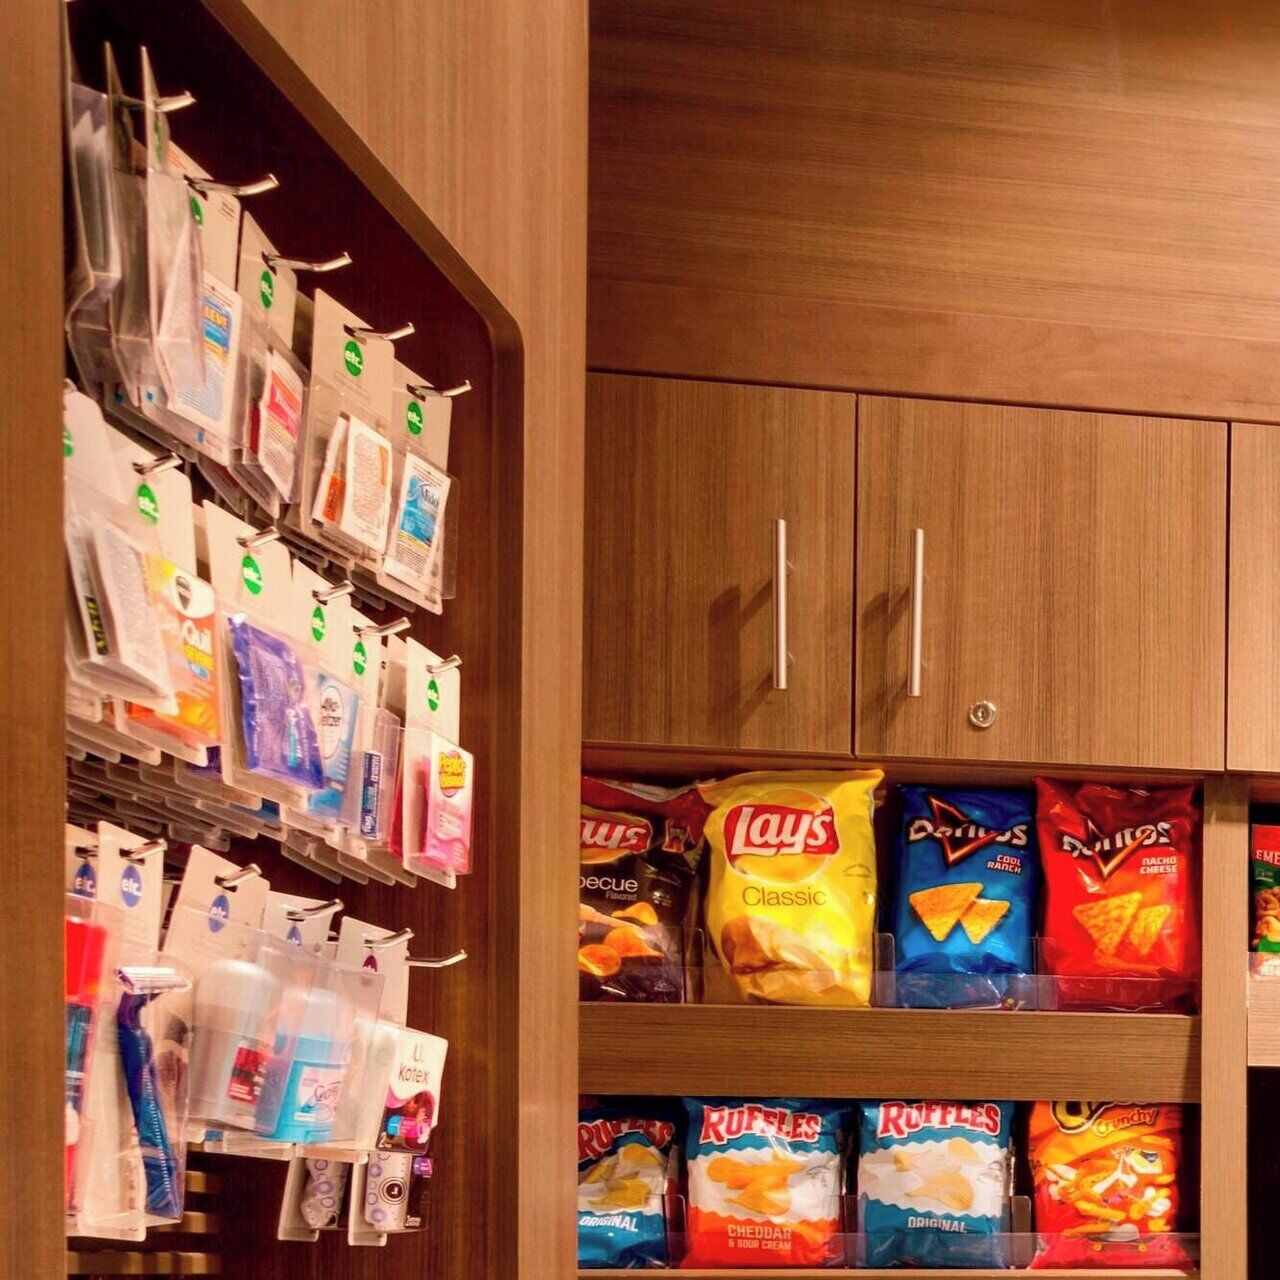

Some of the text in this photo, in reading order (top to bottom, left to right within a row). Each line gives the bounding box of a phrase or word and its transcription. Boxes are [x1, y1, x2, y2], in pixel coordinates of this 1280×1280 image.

[731, 807, 830, 856] Lay's
[987, 861, 1022, 874] RANCH
[996, 854, 1022, 867] COOL
[1139, 864, 1179, 875] CHEESE
[1141, 856, 1178, 866] NACHO
[742, 885, 827, 907] Classic
[700, 1105, 822, 1144] RUFFLES
[879, 1102, 1000, 1137] RUFFLES
[1093, 1107, 1160, 1137] Crunchy
[579, 1214, 639, 1232] ORIGINAL
[727, 1223, 793, 1240] CHEDDAR
[907, 1216, 968, 1234] ORIGINAL
[737, 1239, 792, 1251] SOUR CREAM
